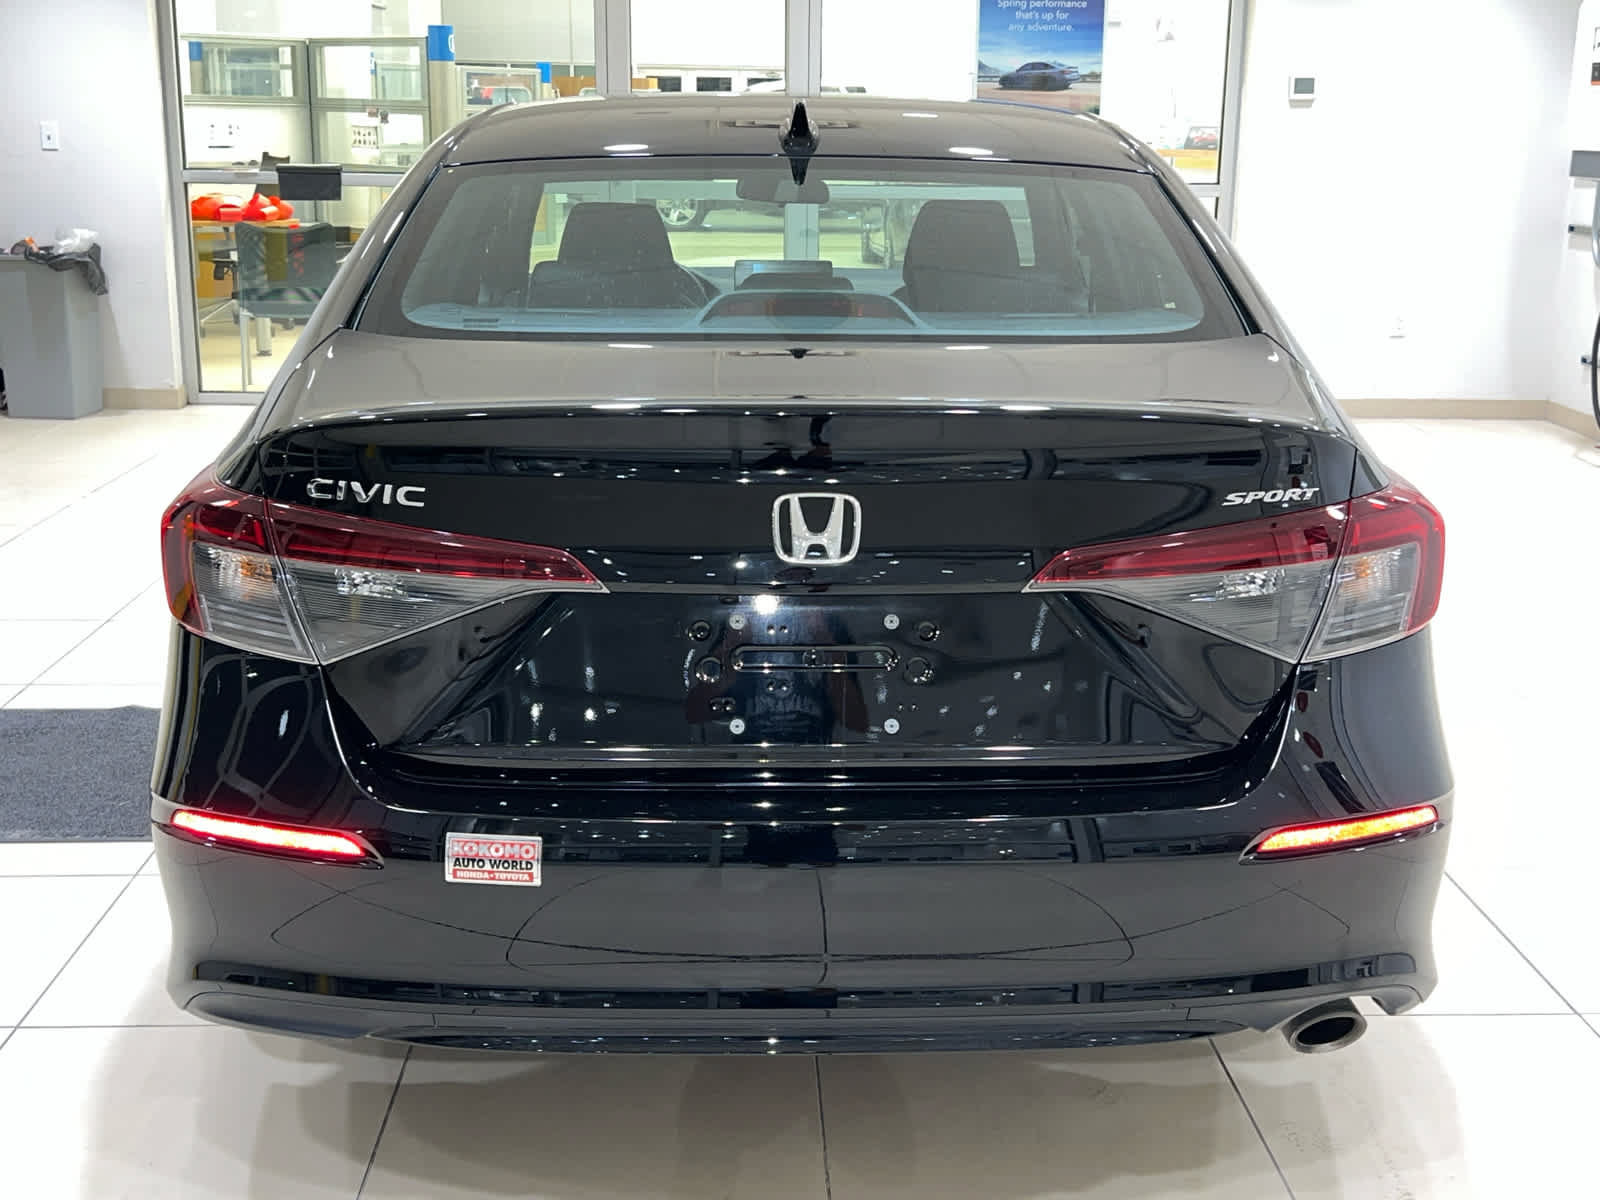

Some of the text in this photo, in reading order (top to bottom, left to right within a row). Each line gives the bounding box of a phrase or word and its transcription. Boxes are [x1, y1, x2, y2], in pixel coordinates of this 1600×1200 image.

[997, 0, 1088, 9] Spring performance
[1015, 10, 1069, 21] that's up for
[1008, 22, 1075, 32] any adventure.
[306, 478, 426, 507] CIVIC
[1221, 487, 1320, 506] SPORT
[452, 840, 535, 859] KOKOMO
[453, 857, 534, 871] AUTO WORLD
